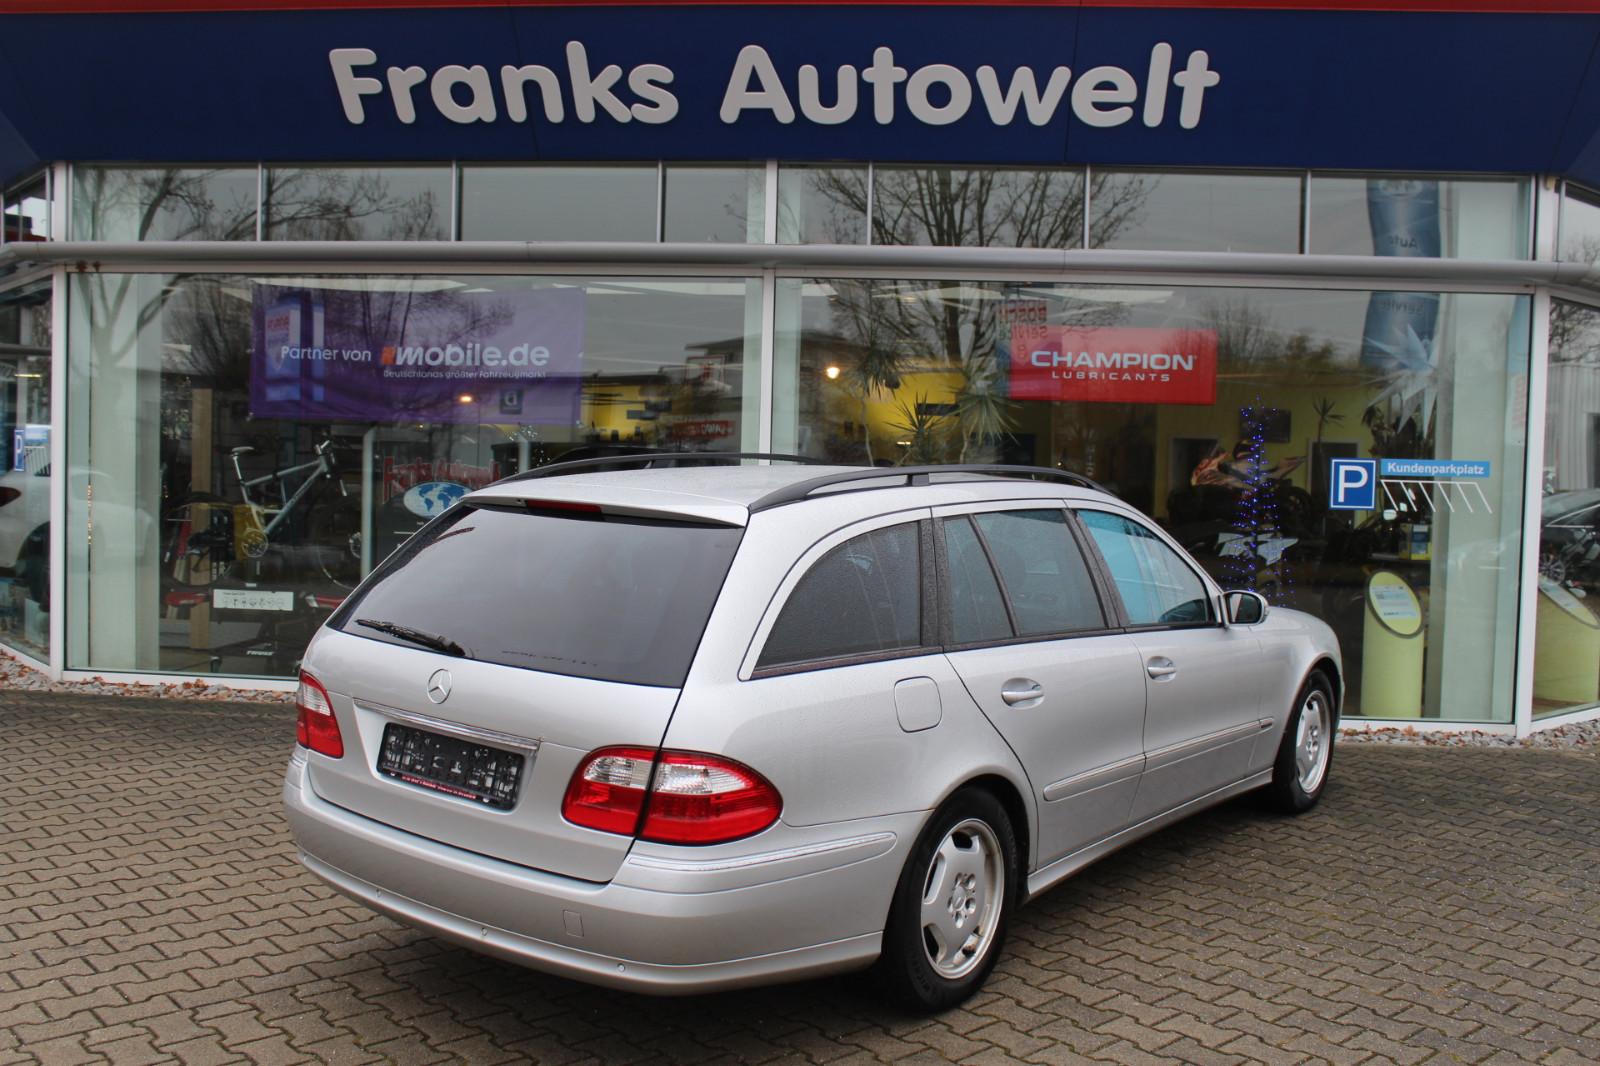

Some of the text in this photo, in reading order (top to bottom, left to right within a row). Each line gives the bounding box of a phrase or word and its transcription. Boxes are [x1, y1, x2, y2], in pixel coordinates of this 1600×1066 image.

[328, 40, 1221, 129] Franks Autowelt
[281, 345, 372, 361] Partner von
[395, 342, 550, 367] mobile.de
[1031, 350, 1194, 371] CHAMPION
[1052, 371, 1171, 382] LUBRICANTS
[1387, 461, 1485, 476] Kundenparkplatz
[1338, 464, 1368, 503] P
